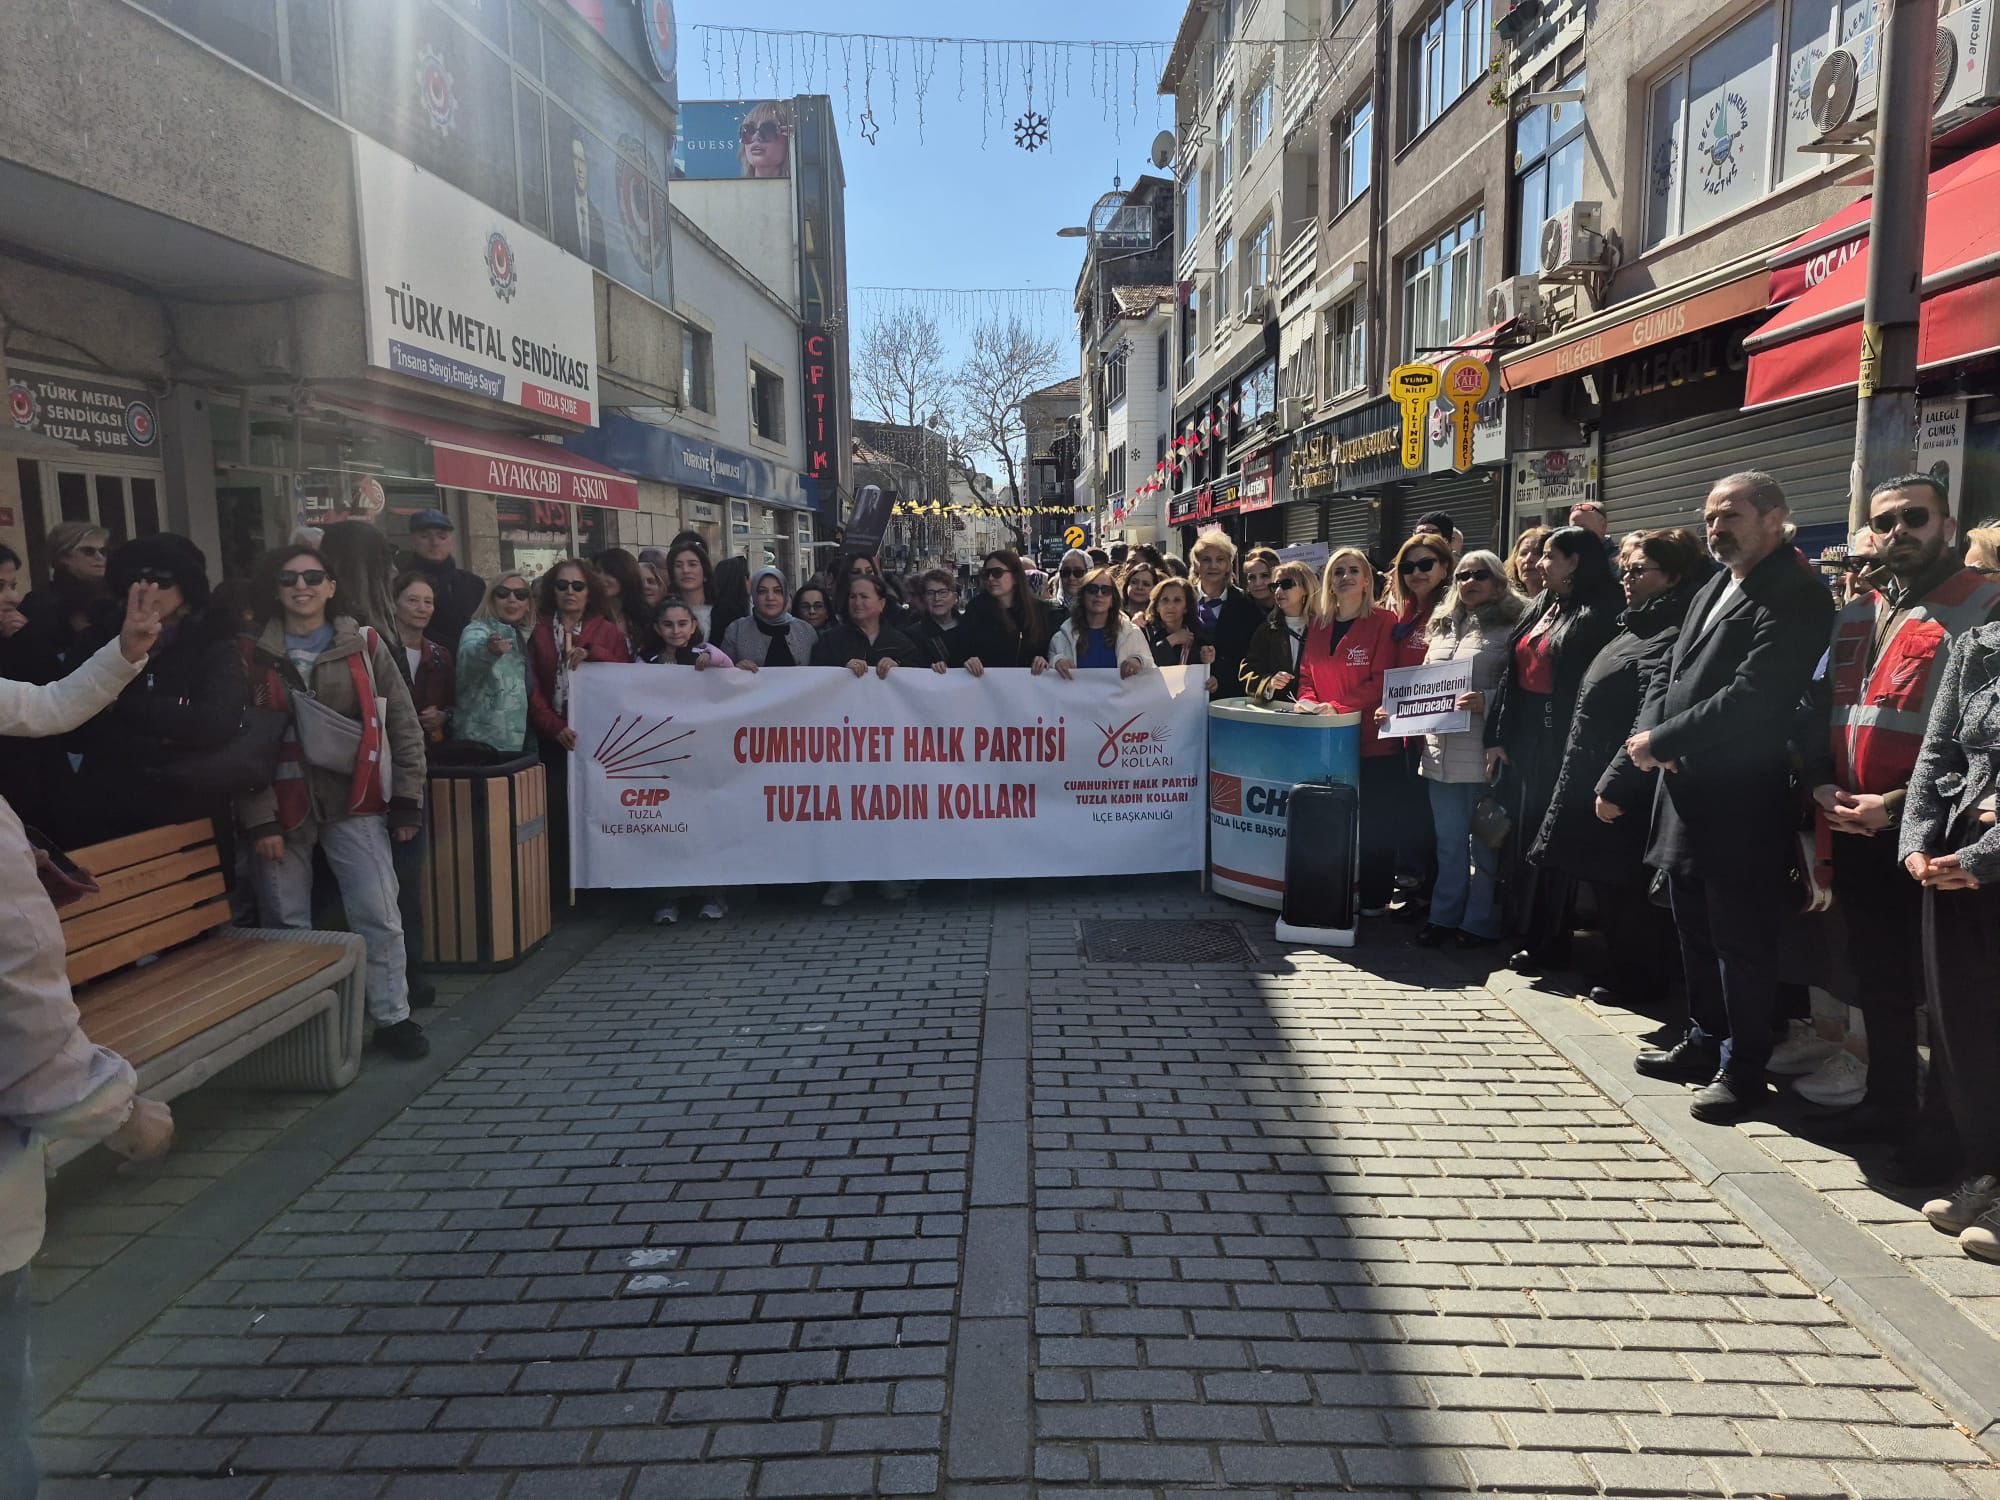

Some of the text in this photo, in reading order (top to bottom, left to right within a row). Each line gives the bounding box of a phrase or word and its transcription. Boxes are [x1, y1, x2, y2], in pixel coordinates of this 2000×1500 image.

[1968, 6, 1982, 55] arçelik
[687, 140, 734, 149] GUESS
[385, 282, 590, 391] TÜRK METAL SENDİKASI
[37, 382, 126, 410] TÜRK METAL
[537, 389, 578, 417] TUZLA ŞUBE
[47, 405, 123, 427] SENDİKASI
[43, 423, 129, 447] TUZLA ŞUBE
[682, 448, 710, 472] TÜRKİYE
[488, 460, 608, 504] AYAKKABI AŞKIN
[1388, 675, 1466, 699] Kadın Cinayetlerini
[1399, 697, 1454, 716] Durduracağız
[733, 716, 1065, 764] CUMHURİYET HALK PARTİSİ
[1121, 732, 1150, 744] CHP
[1121, 743, 1163, 756] KADIN
[1121, 756, 1173, 768] KOLLARI
[1064, 775, 1198, 791] CUMHURİYET HALK PARTİSİ
[620, 788, 671, 807] CHP
[764, 783, 1036, 822] TUZLA KADIN KOLLARI
[1075, 792, 1188, 805] TUZLA KADIN KOLLARI
[628, 809, 663, 820] TUZLA
[1115, 809, 1173, 823] BAŞKANLIĞI
[1211, 813, 1230, 828] TUZLA
[1233, 817, 1253, 833] İLÇE
[626, 821, 688, 836] BAŞKANLIĞI
